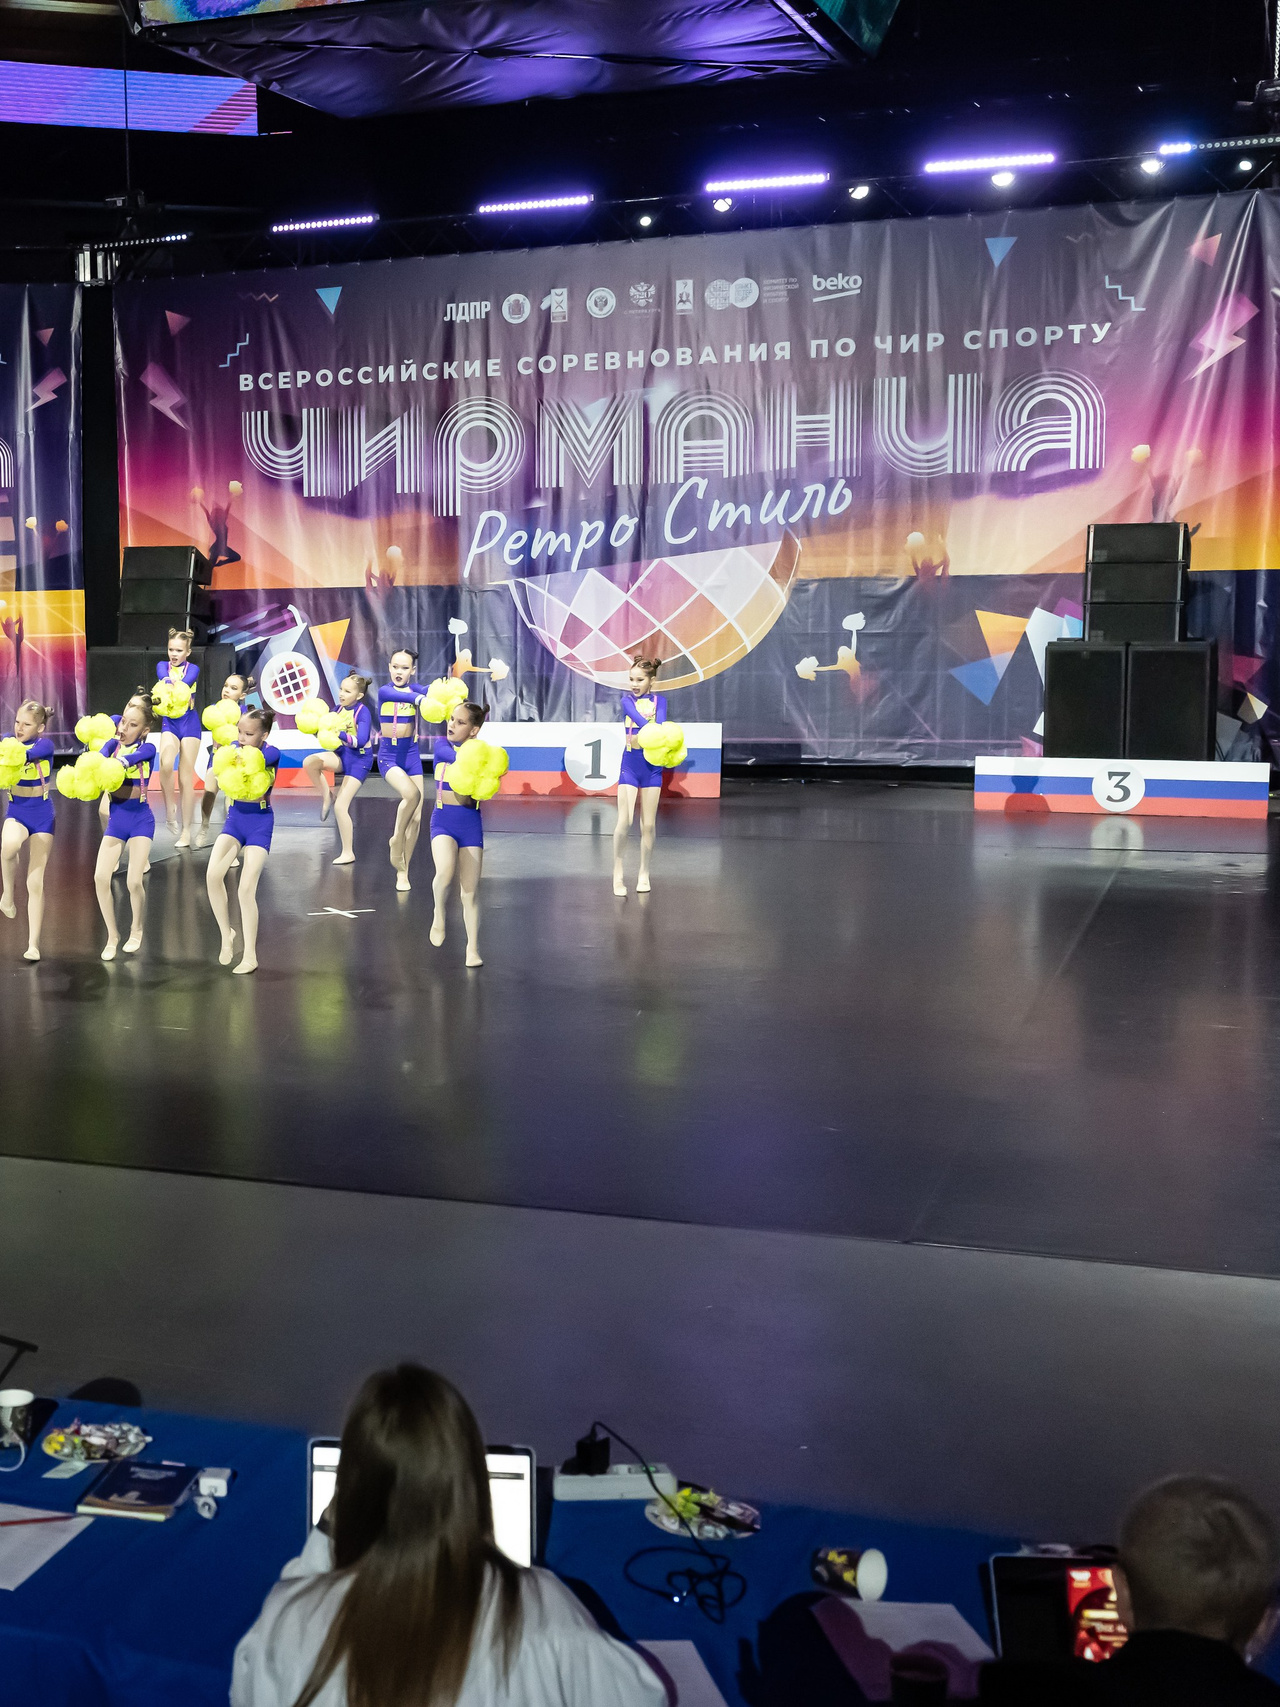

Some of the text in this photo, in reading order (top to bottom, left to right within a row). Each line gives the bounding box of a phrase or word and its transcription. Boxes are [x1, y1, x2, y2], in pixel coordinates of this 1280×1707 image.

[812, 273, 862, 291] beko
[443, 301, 491, 323] ЛДПР
[238, 322, 1112, 392] ВСЕРОССИЙСКИЕ СОРЕВНОВАНИЯ ПО ЧИР СПОРТУ
[462, 476, 854, 578] Ретро Стиль
[585, 739, 606, 779] 1
[1106, 771, 1131, 803] 3
